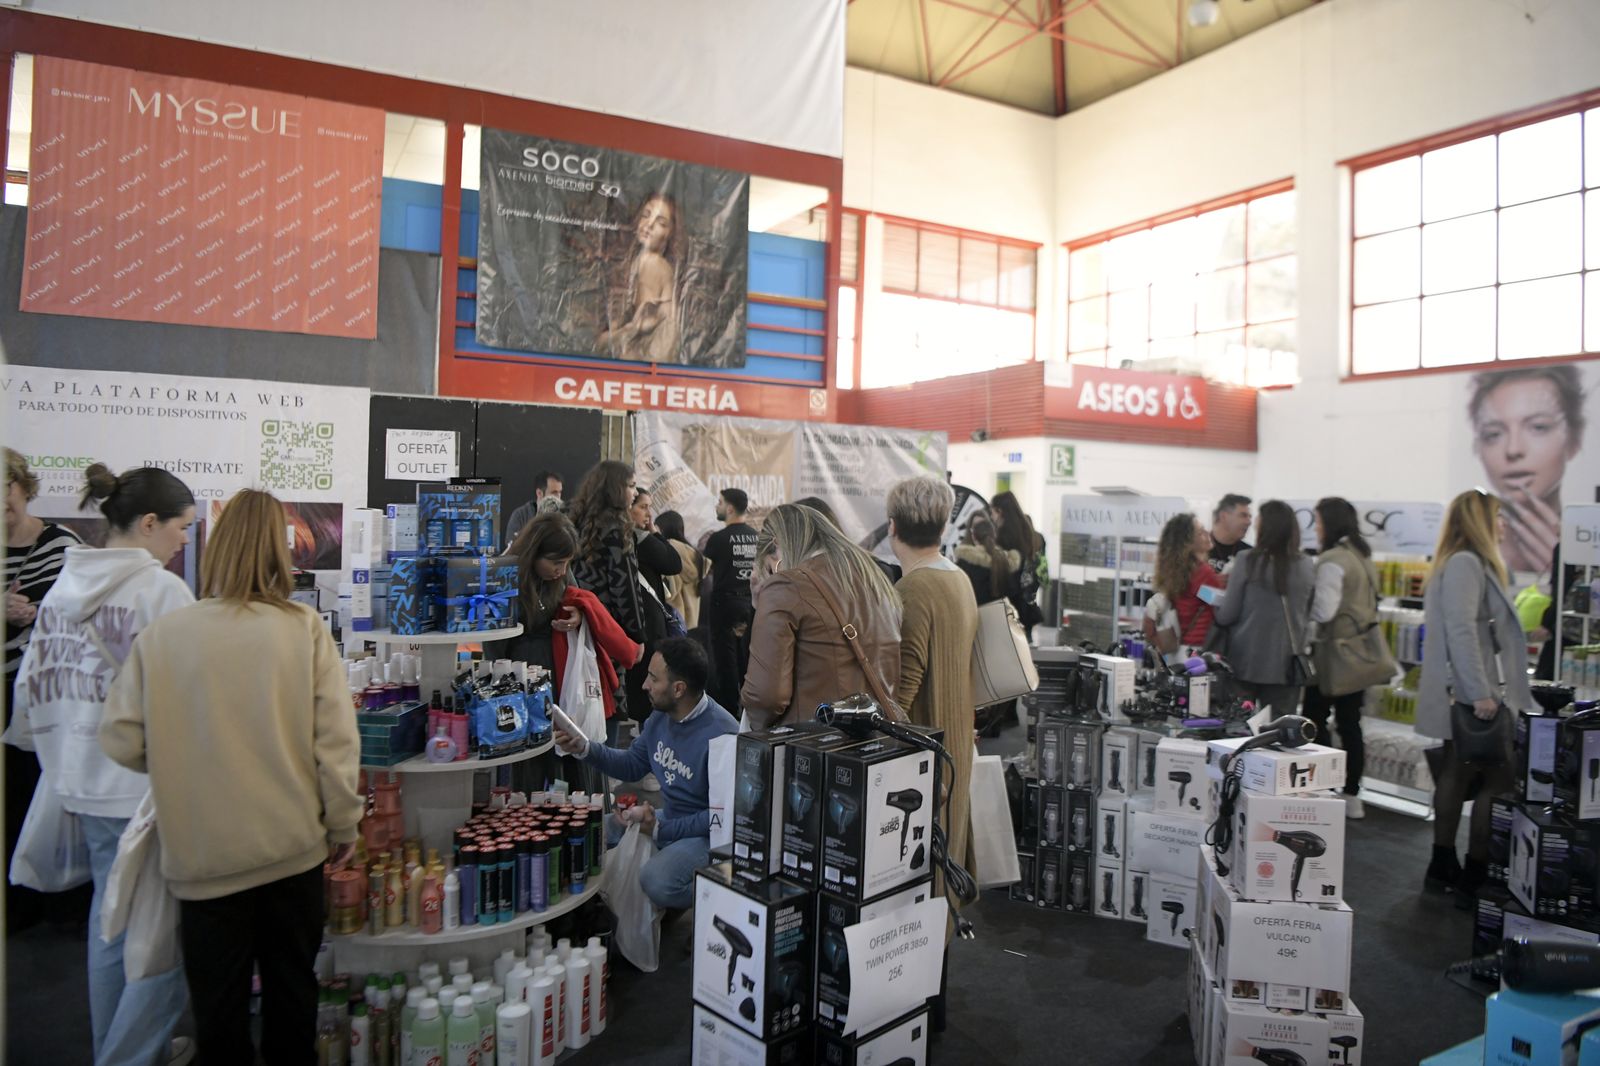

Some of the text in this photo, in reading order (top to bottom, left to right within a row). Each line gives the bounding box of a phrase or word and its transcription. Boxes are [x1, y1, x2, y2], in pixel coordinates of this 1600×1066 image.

[522, 147, 599, 178] SOCO
[498, 167, 538, 183] AXENIA
[54, 381, 238, 404] PLATAFORMA
[258, 393, 304, 408] WEB
[554, 377, 738, 411] CAFETERÍA
[1077, 380, 1160, 417] ASEOS
[19, 400, 248, 421] PARA TODO TIPO DE DISPOSITIVOS
[398, 443, 448, 454] OFERTA
[398, 462, 448, 474] OUTLET
[356, 571, 365, 583] 6
[880, 822, 900, 836] 3850
[1254, 917, 1321, 931] OFERTA FERIA
[869, 920, 921, 949] OFERTA FERIA
[1266, 932, 1311, 944] VULCANO
[866, 937, 928, 971] TWIN POWER 3850
[1277, 948, 1298, 958] 49€
[888, 964, 903, 981] 25€
